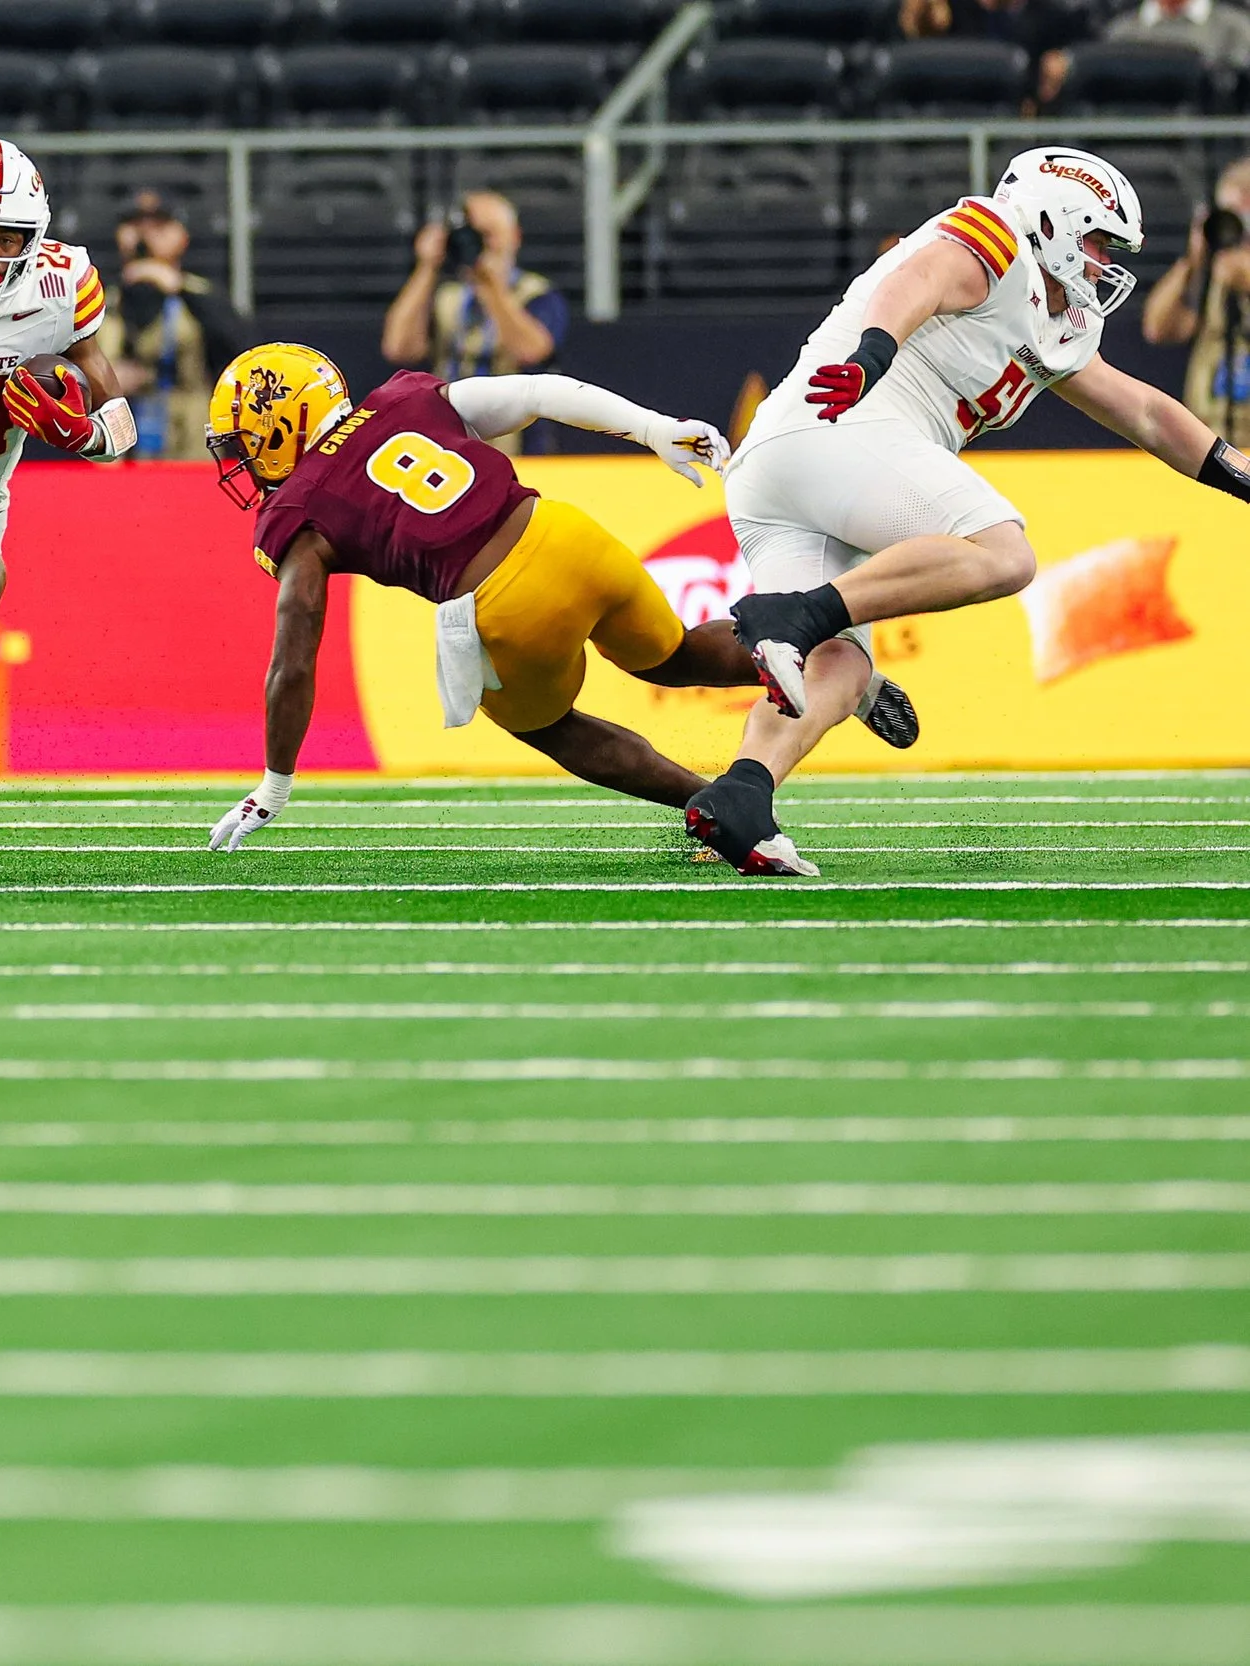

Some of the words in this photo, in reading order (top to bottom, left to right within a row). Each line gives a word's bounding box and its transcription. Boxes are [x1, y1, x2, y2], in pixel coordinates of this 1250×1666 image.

[1039, 159, 1119, 211] Cyclones
[1016, 344, 1040, 367] IOWA
[318, 408, 378, 456] CROOK
[366, 431, 476, 515] 8
